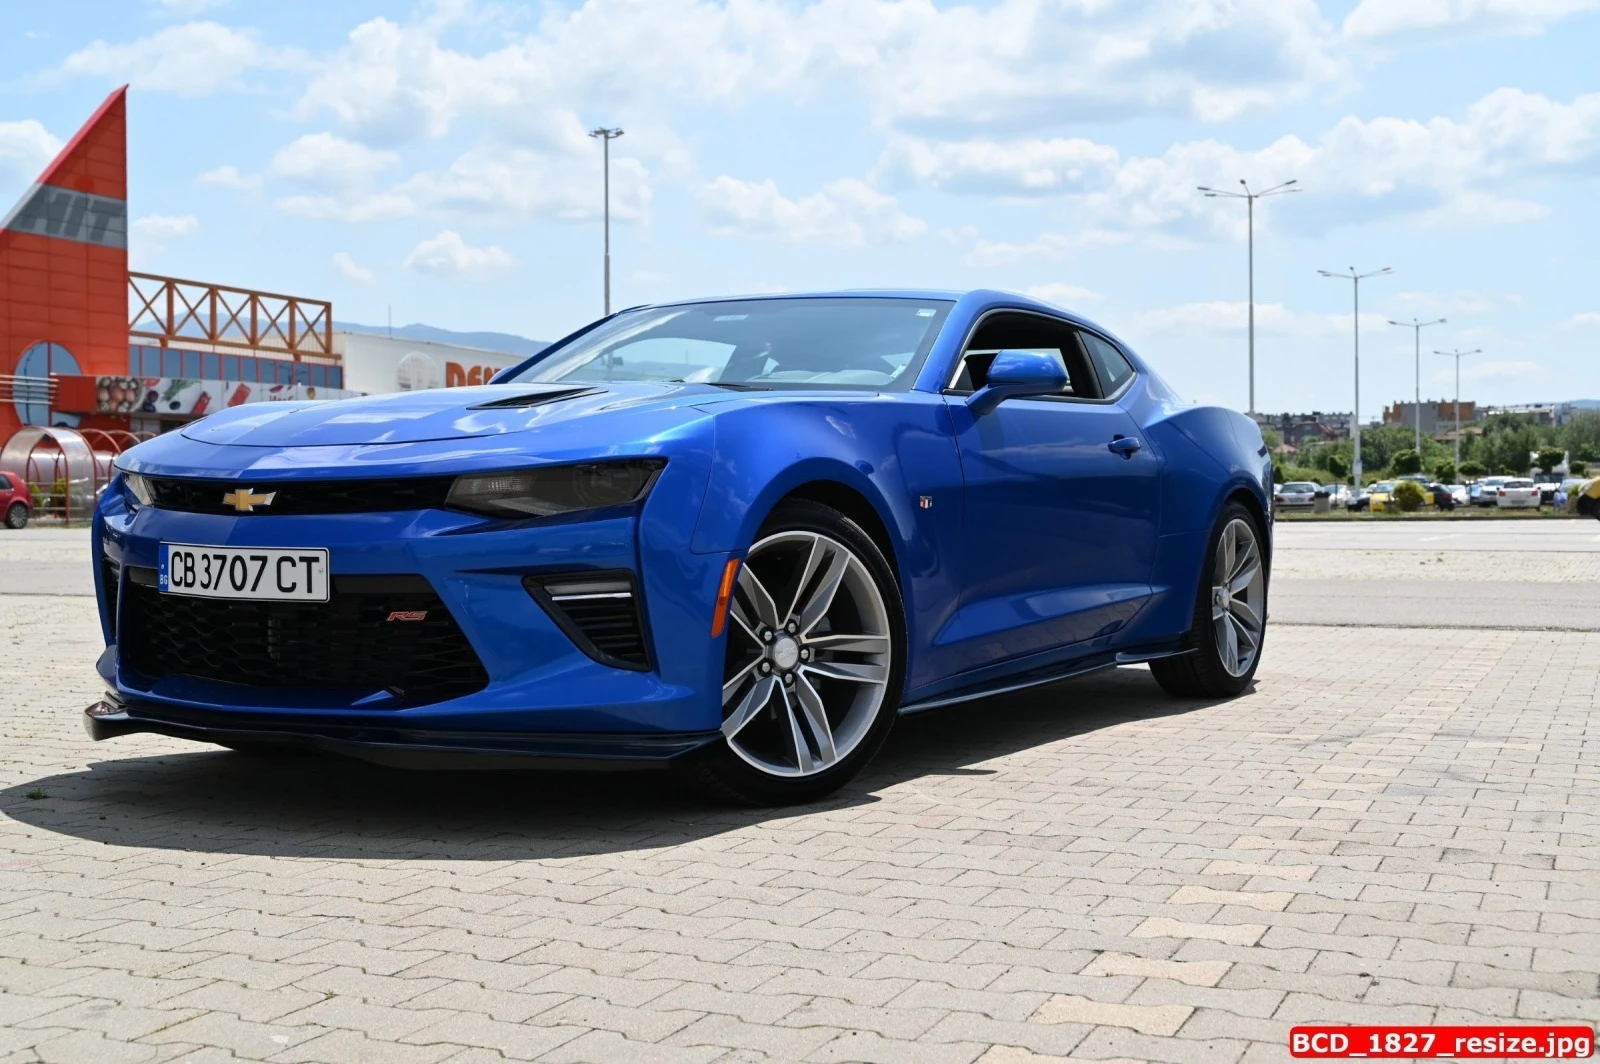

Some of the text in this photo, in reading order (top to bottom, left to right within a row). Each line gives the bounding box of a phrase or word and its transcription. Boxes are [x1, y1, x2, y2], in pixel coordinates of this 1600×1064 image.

[171, 551, 320, 593] CB 3707 CT
[159, 574, 168, 585] BG
[387, 611, 428, 621] RS
